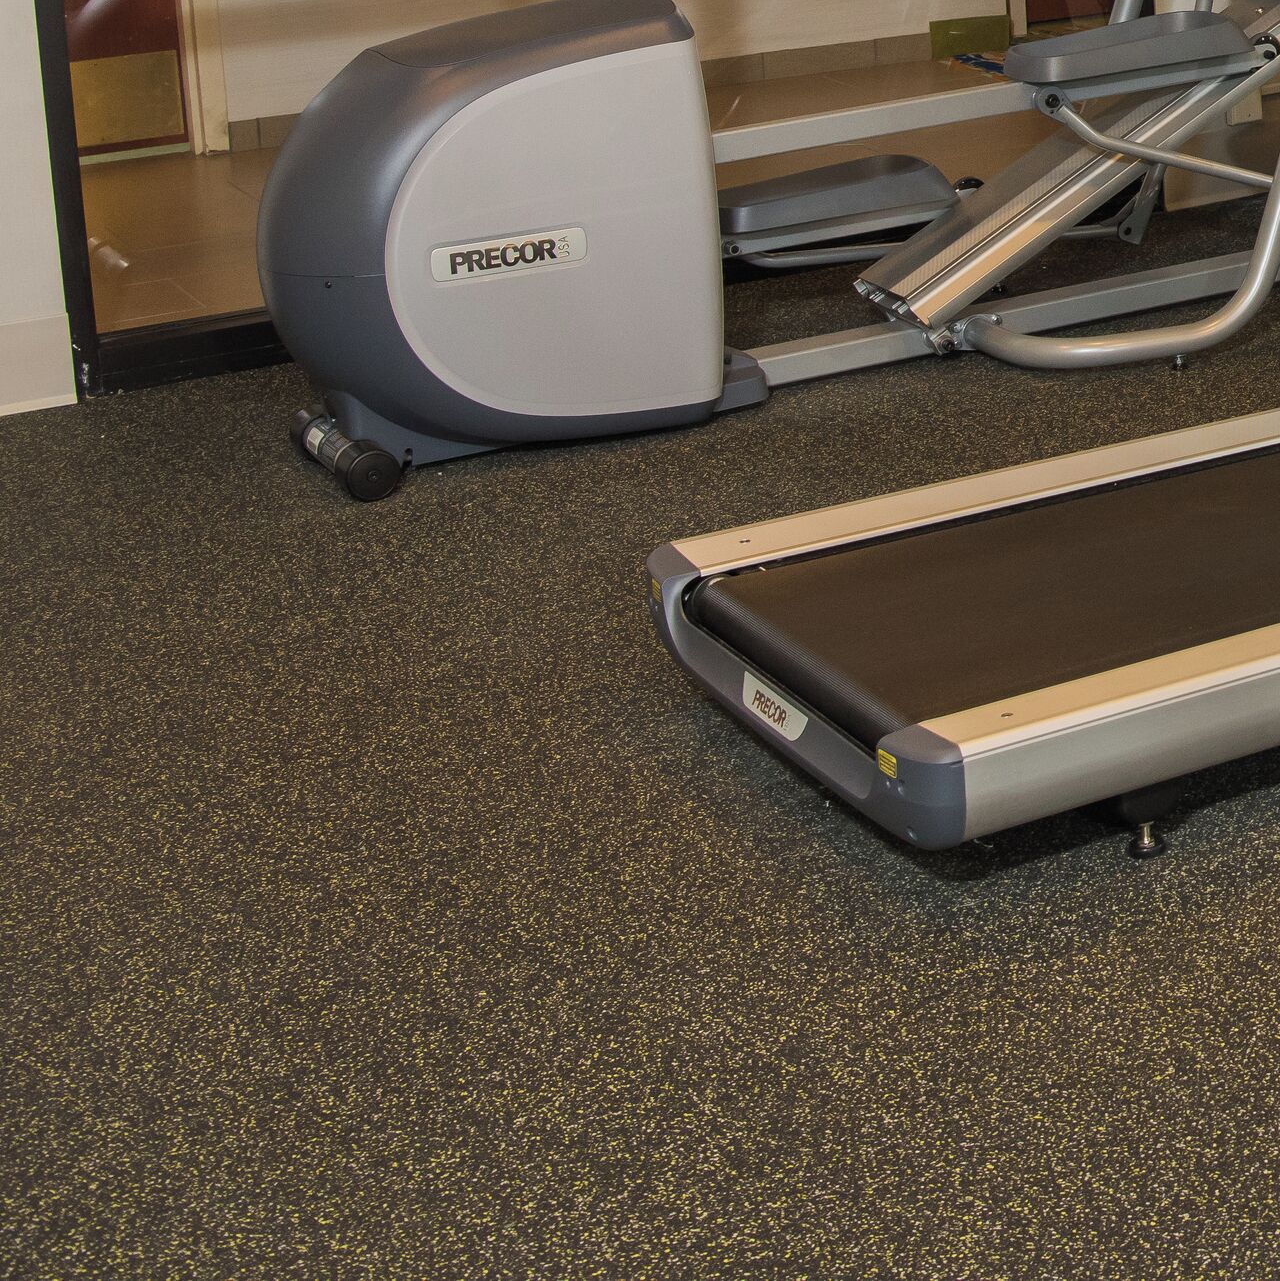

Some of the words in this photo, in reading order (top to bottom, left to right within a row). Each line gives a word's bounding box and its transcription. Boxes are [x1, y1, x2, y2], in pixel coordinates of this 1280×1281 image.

[450, 238, 557, 275] PRECOR
[557, 235, 571, 259] USA
[752, 689, 787, 728] PRECOR
